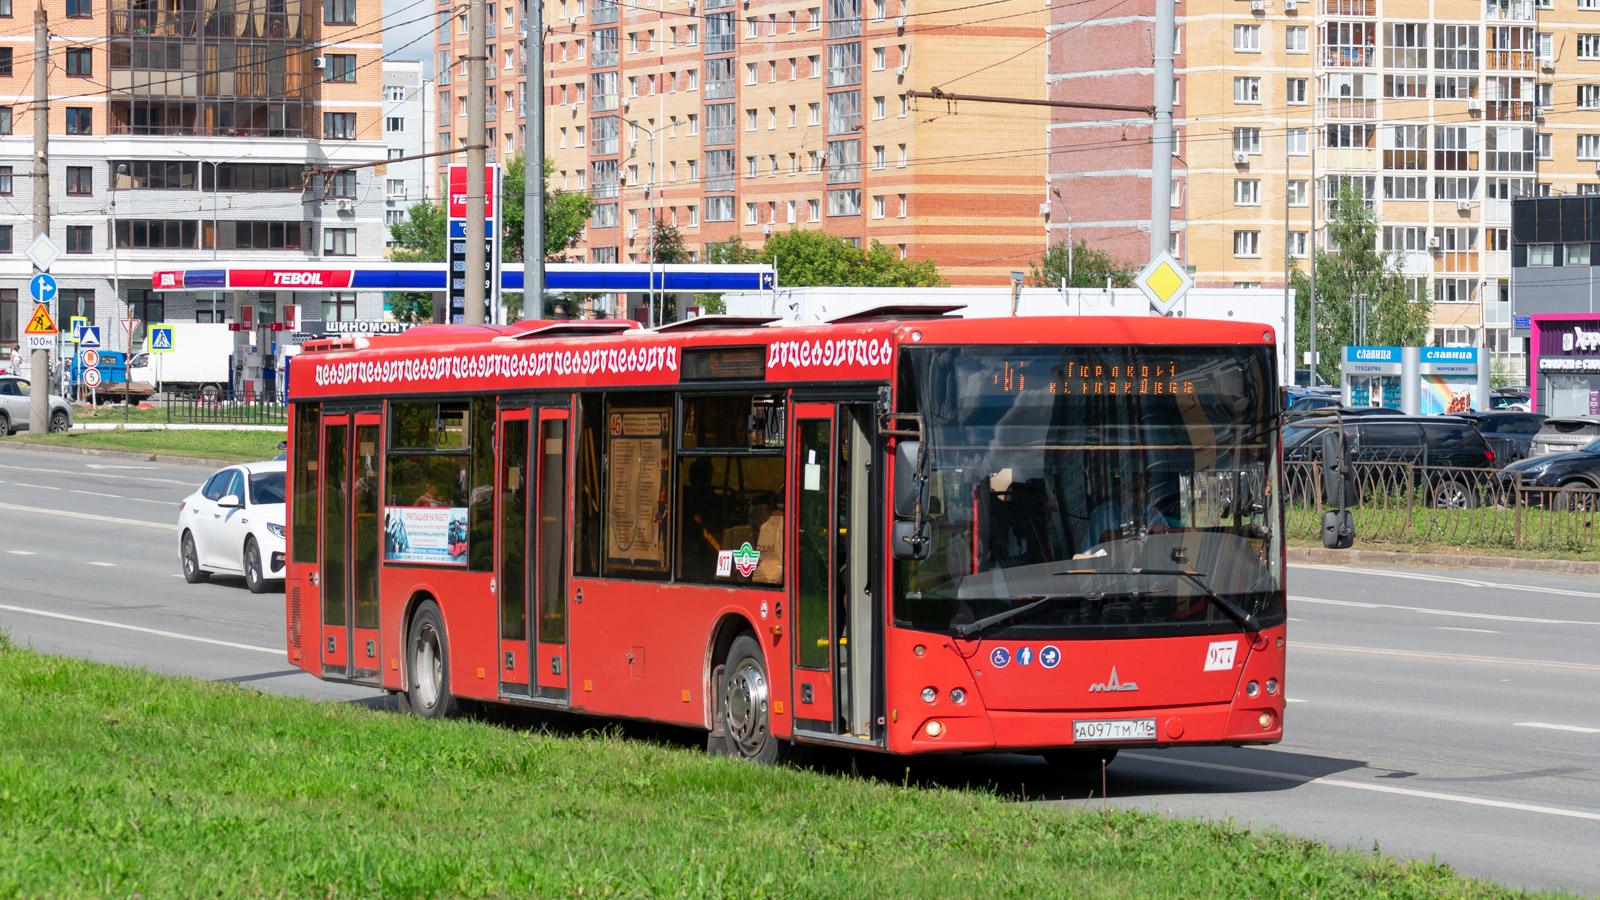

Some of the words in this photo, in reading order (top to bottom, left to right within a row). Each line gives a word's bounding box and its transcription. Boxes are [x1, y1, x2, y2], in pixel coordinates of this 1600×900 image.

[454, 244, 463, 252] 92
[454, 262, 463, 270] 95
[272, 272, 324, 285] TEBOIL
[326, 321, 422, 333] ШИНОМОНТА
[89, 373, 95, 381] 5
[611, 415, 621, 434] 46
[1210, 647, 1233, 664] 977
